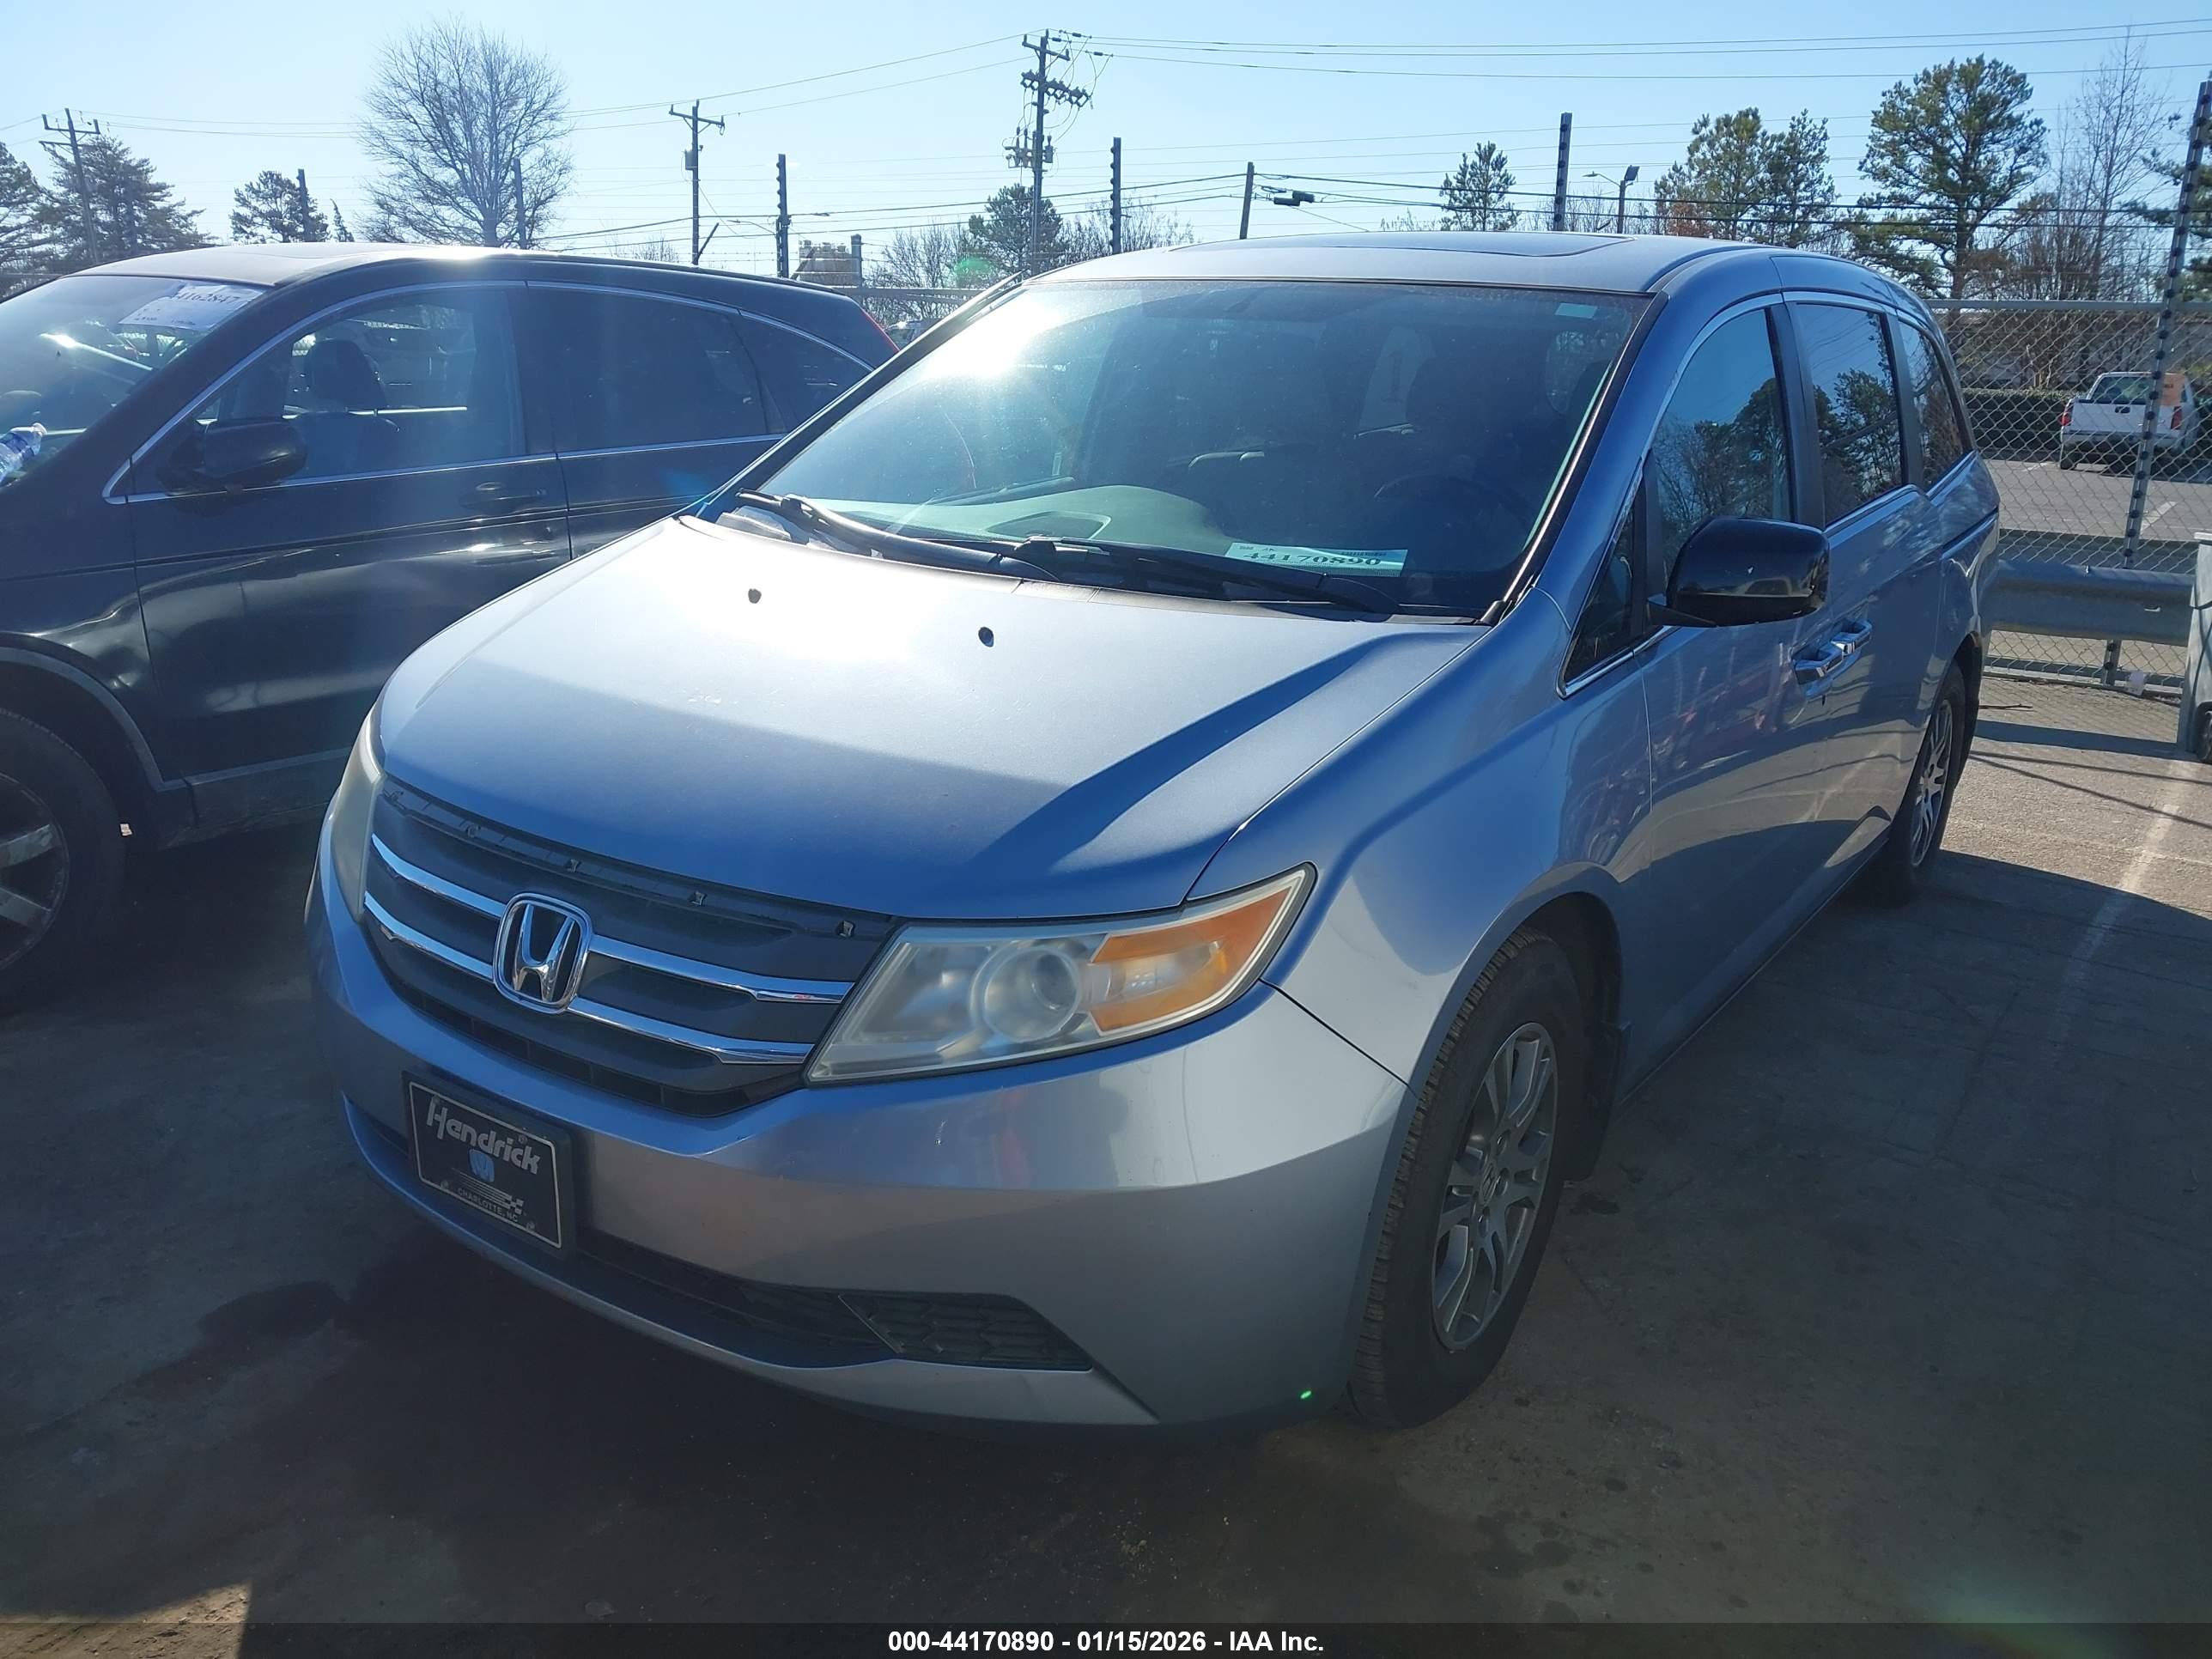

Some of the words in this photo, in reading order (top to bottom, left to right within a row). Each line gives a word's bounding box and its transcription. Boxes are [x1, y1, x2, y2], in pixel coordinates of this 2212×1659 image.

[1243, 551, 1382, 566] 44170890
[426, 1094, 542, 1175] Hendrick
[507, 1210, 519, 1223] NC
